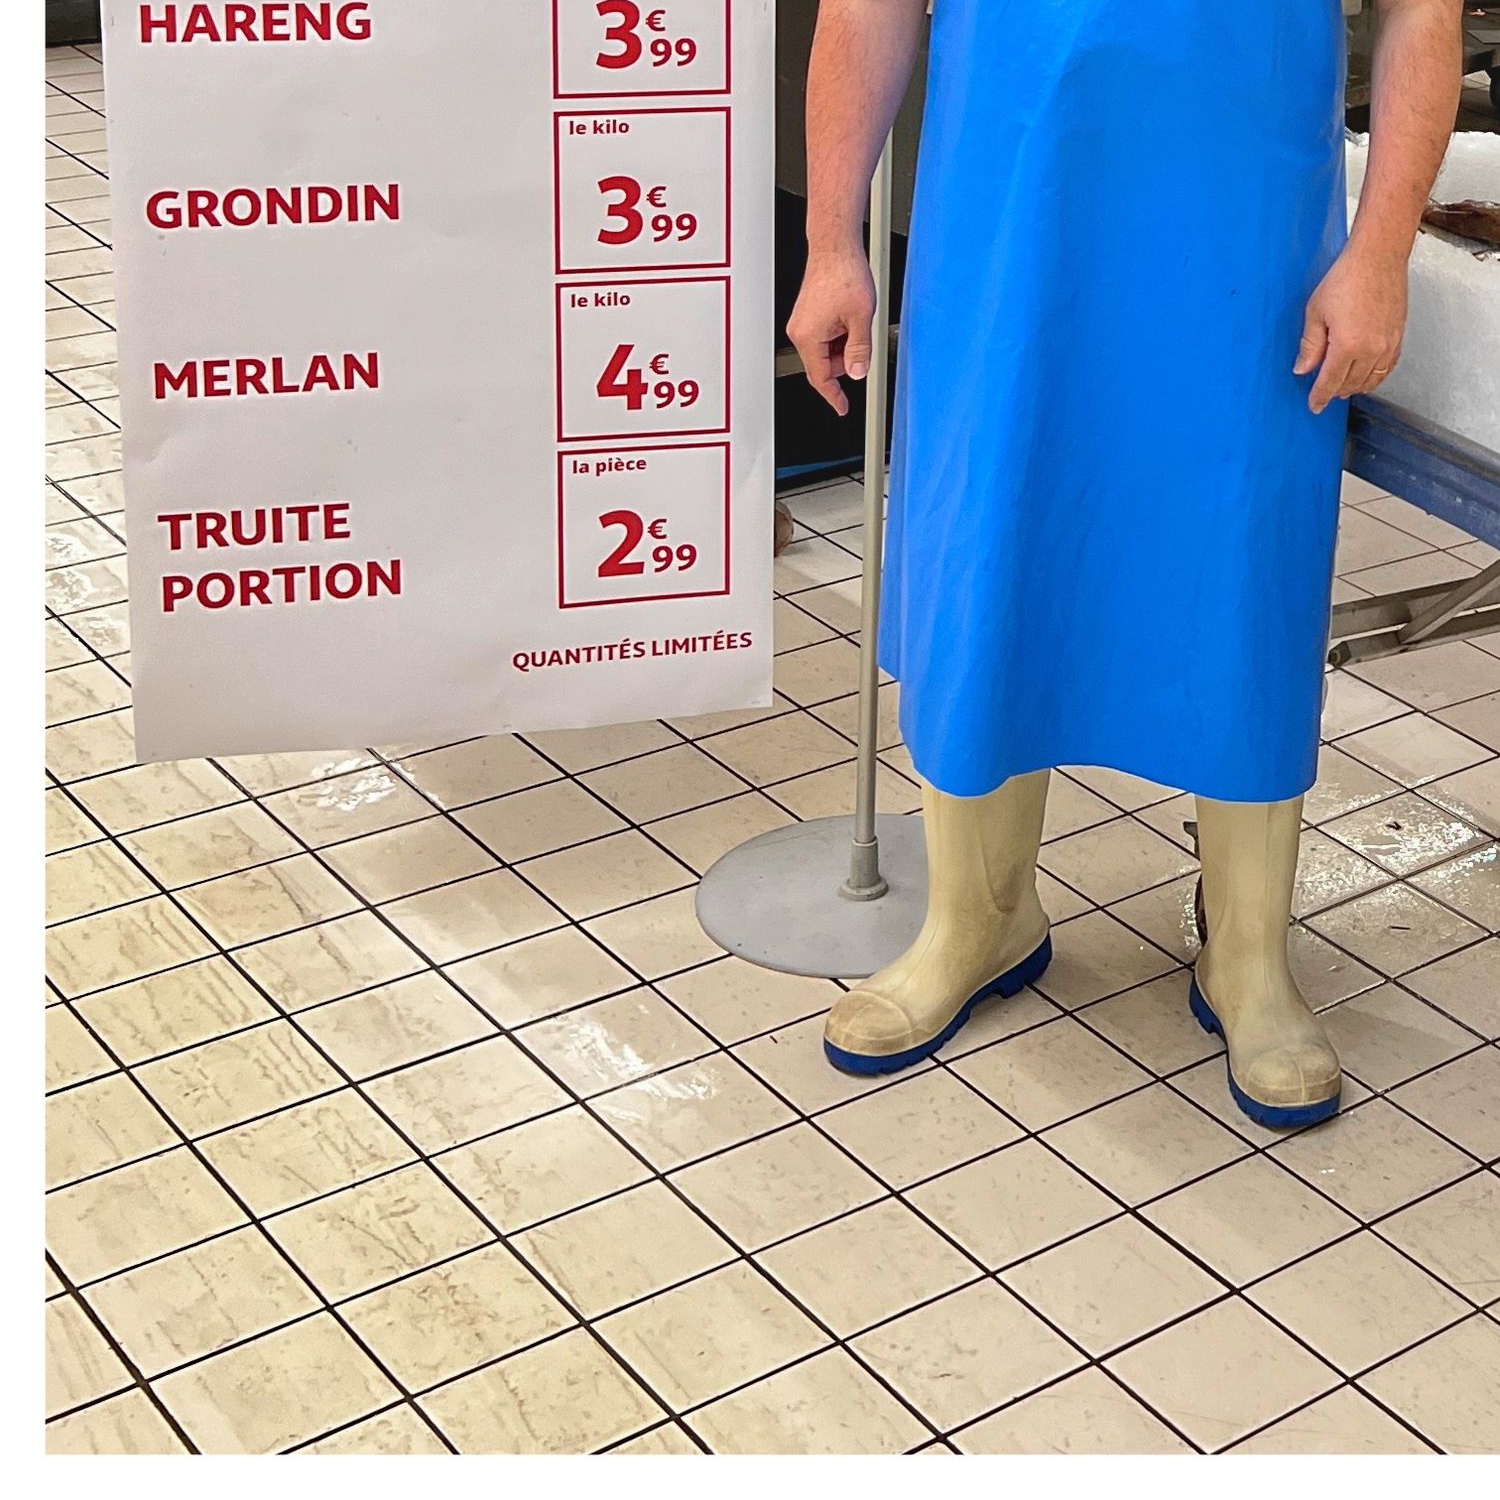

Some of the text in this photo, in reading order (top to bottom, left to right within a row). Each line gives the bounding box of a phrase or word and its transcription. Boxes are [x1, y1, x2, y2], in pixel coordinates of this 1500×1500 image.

[139, 2, 373, 43] HARENG
[569, 119, 630, 136] le kilo
[145, 183, 401, 230] GRONDIN
[570, 291, 632, 309] le kilo
[153, 352, 380, 400] MERLAN
[572, 455, 648, 477] la pièce
[158, 503, 351, 551] TRUITE
[161, 559, 402, 613] PORTION
[512, 630, 753, 672] QUANTITÉS LIMITÉES
